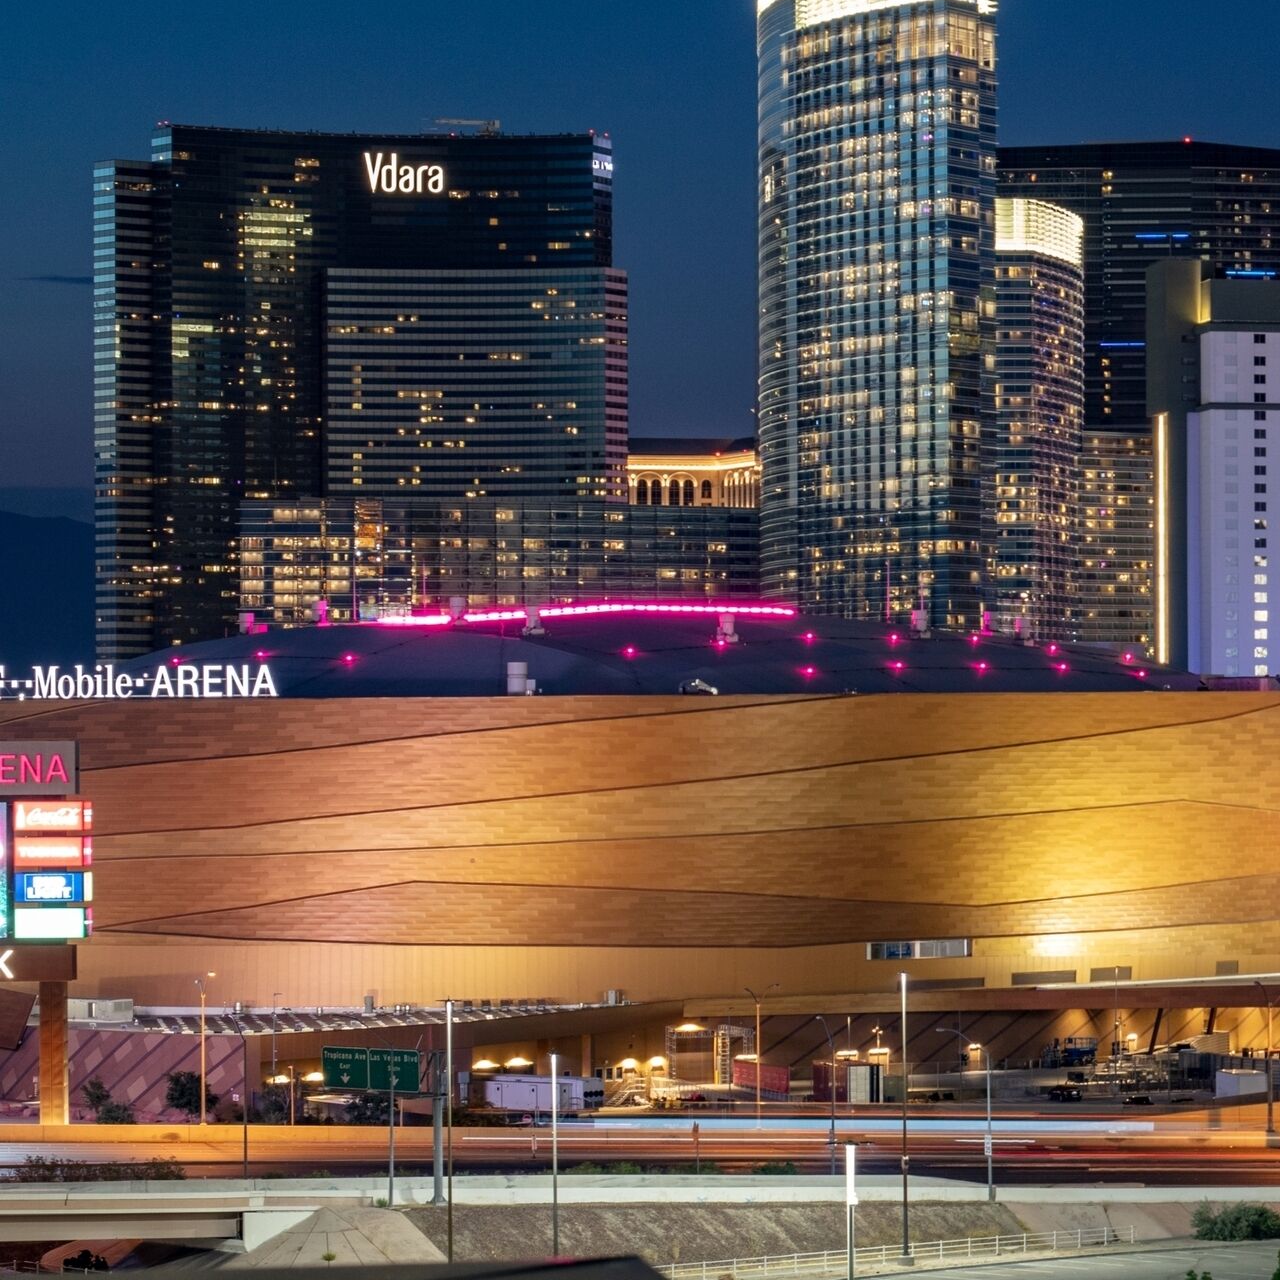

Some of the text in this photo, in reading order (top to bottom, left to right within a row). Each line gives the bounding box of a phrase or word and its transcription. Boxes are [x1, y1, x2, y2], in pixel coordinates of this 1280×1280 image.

[363, 152, 444, 193] Vdara
[324, 1051, 366, 1061] Tropicana Ave
[370, 1053, 380, 1061] Las
[404, 1054, 418, 1063] Blvd
